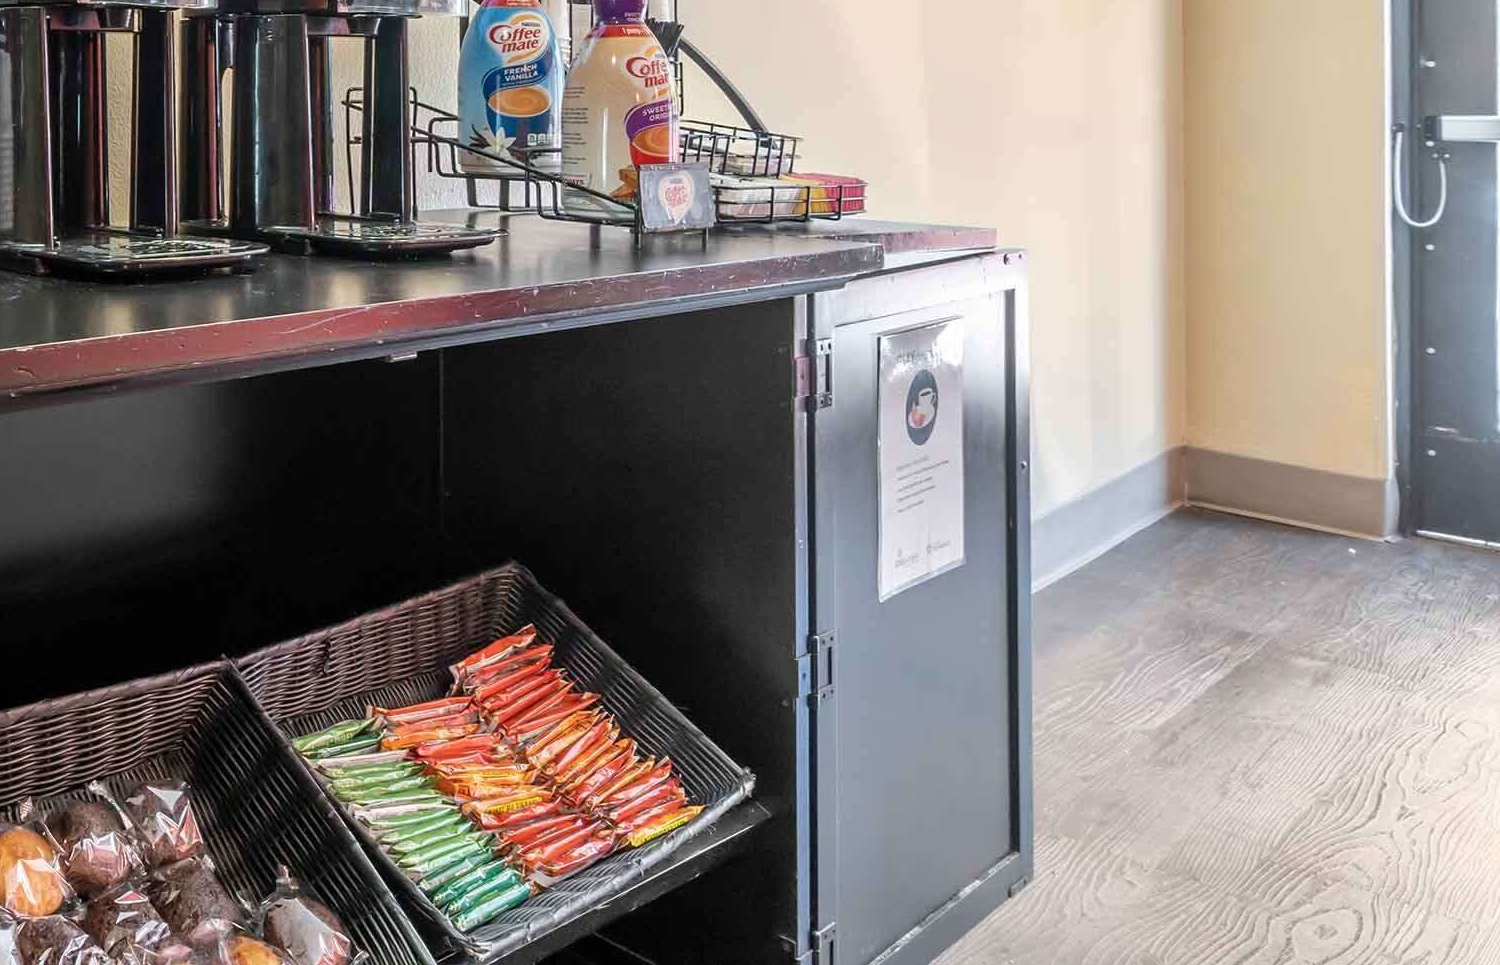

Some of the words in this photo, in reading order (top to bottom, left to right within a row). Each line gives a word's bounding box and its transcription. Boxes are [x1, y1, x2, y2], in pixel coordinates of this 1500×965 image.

[489, 24, 541, 45] Coffee
[501, 39, 540, 53] mate
[503, 63, 538, 75] FRENCH
[626, 56, 669, 78] Coffe
[504, 70, 539, 82] VANILLA
[644, 73, 669, 88] mat
